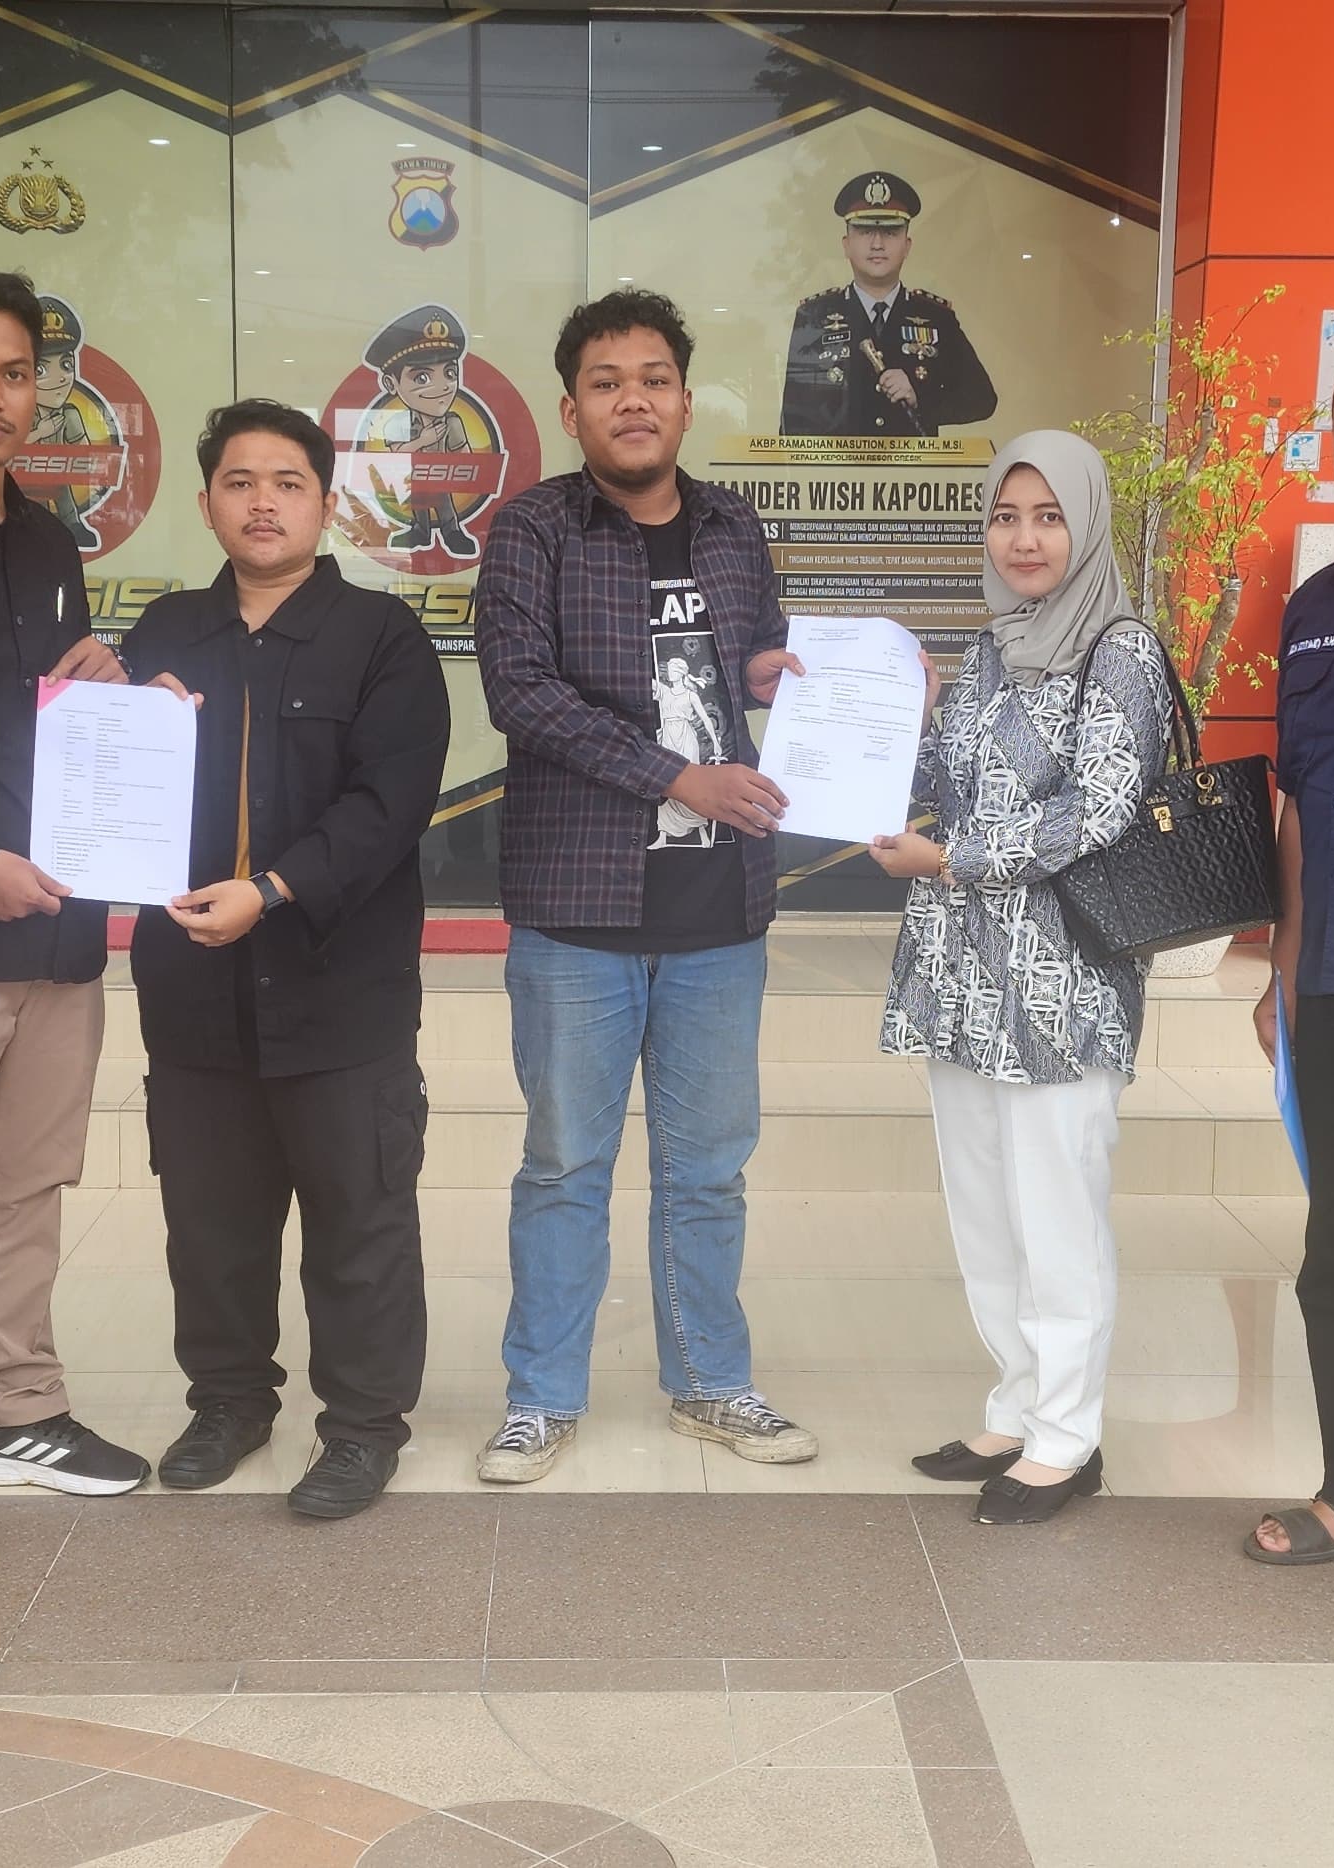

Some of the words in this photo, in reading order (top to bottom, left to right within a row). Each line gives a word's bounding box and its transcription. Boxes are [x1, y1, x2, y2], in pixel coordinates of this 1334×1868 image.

[750, 440, 776, 449] AKBP
[779, 439, 833, 449] RAMADHAN
[836, 440, 887, 450] NASUTION,
[790, 454, 819, 462] KEPALA
[809, 481, 865, 511] WISH
